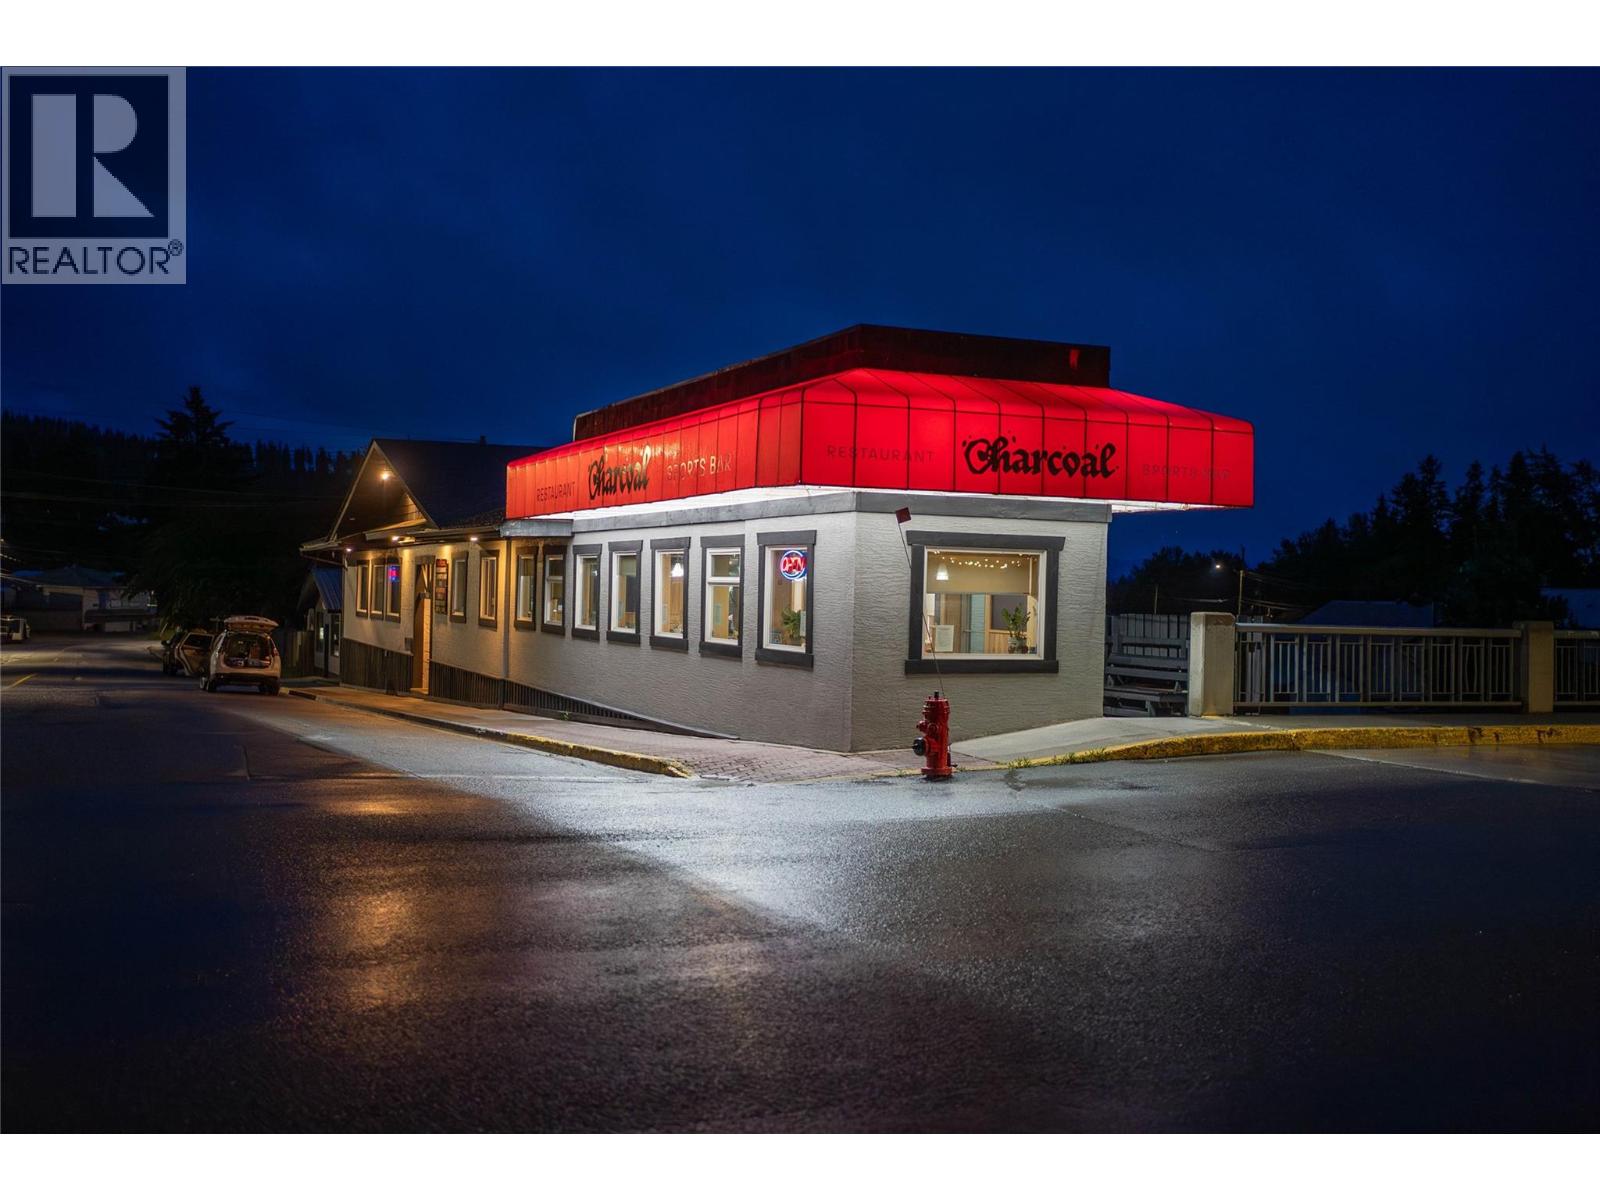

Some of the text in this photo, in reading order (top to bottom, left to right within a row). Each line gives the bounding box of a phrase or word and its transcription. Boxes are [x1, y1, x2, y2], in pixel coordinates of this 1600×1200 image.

[826, 443, 937, 463] RESTAURANT
[960, 430, 1120, 479] Charcoal
[666, 456, 706, 482] SPORTS
[536, 480, 576, 503] RESTAURANT
